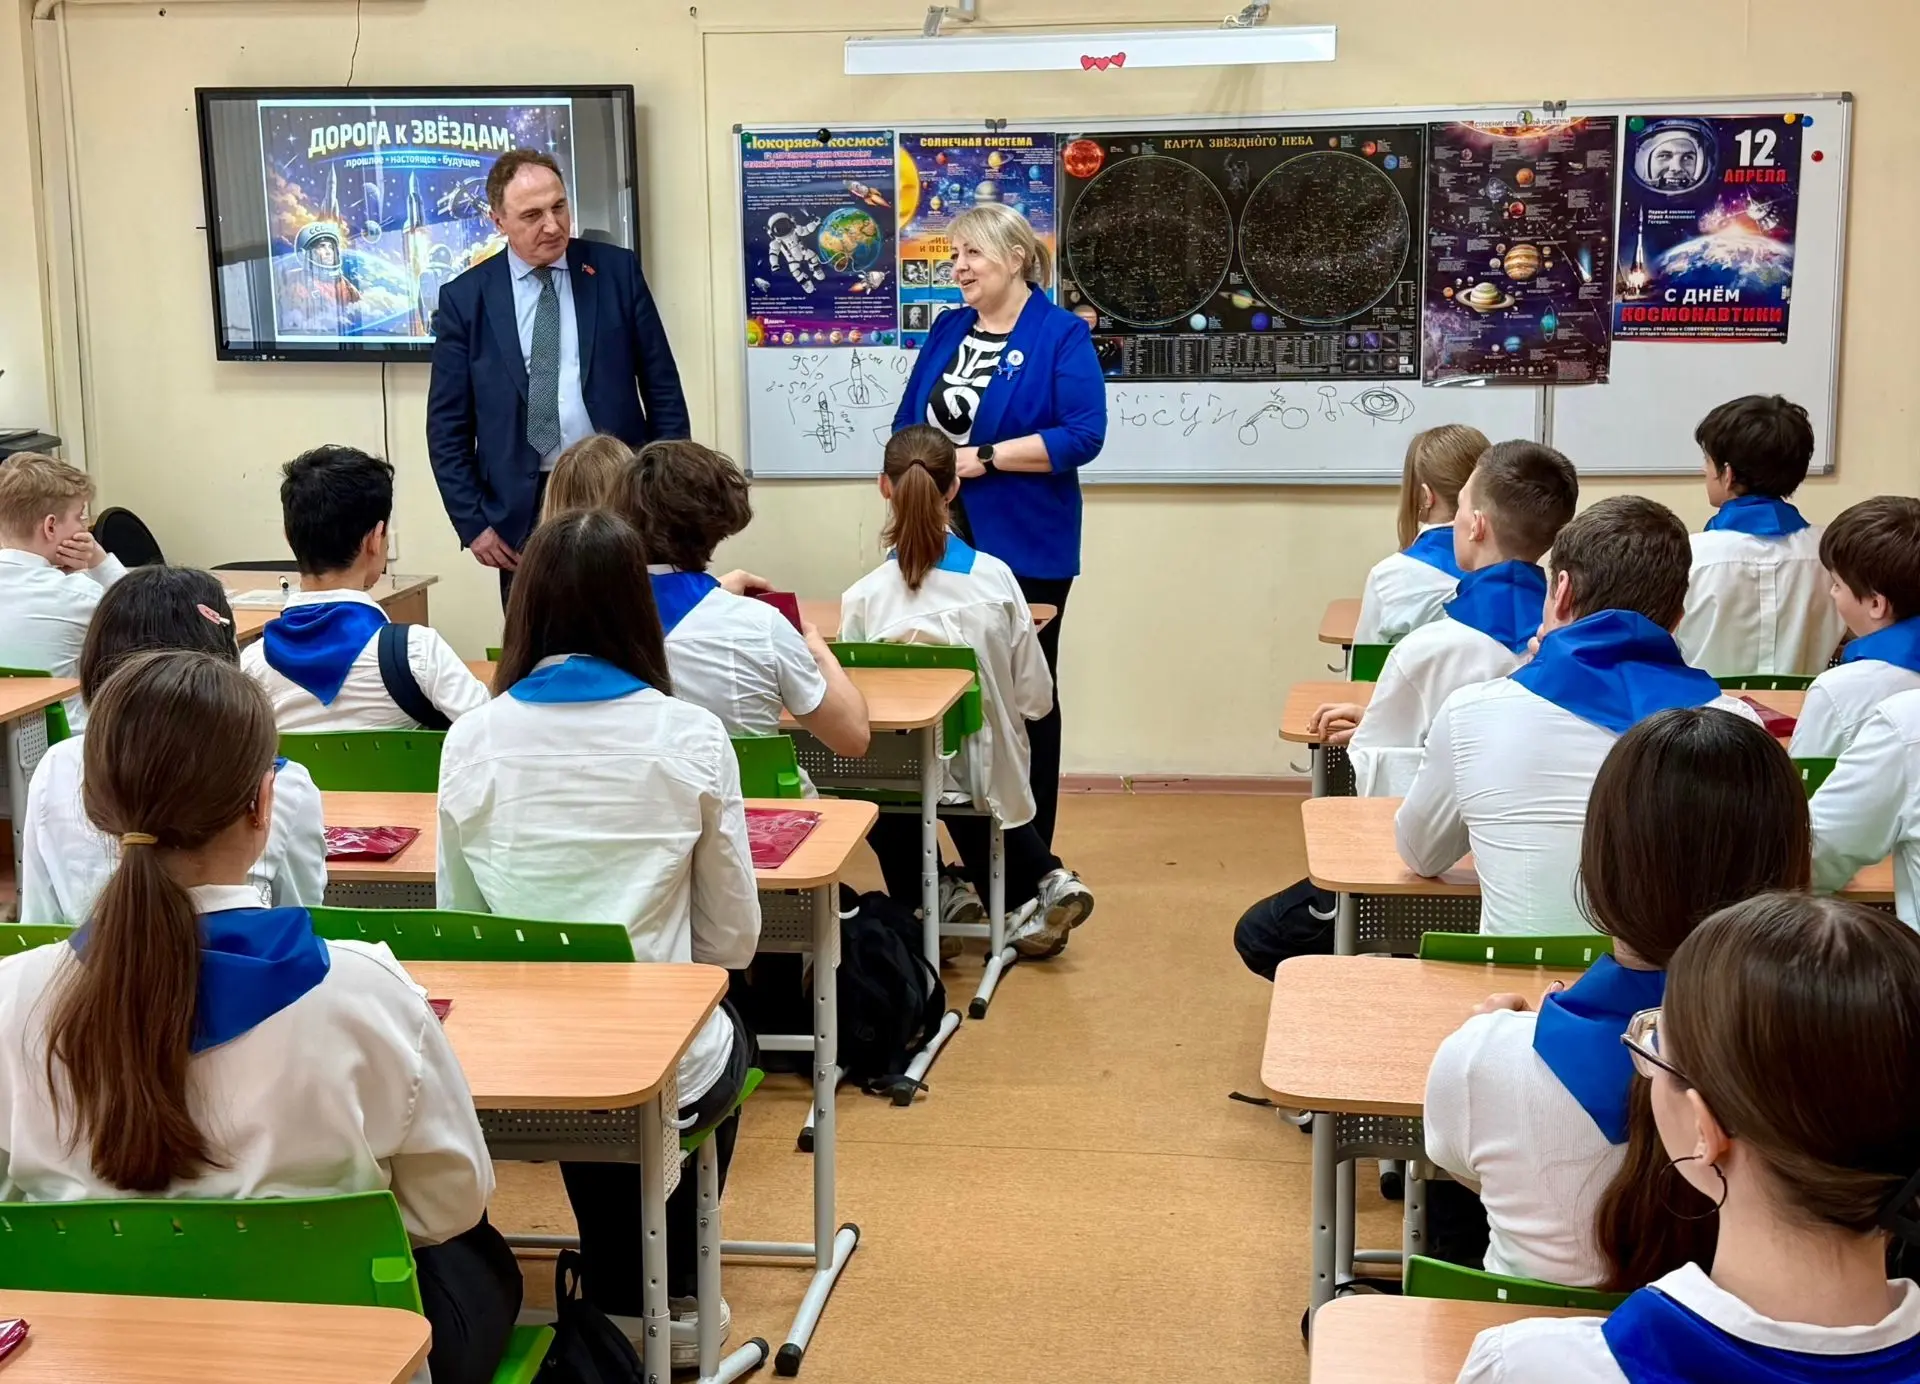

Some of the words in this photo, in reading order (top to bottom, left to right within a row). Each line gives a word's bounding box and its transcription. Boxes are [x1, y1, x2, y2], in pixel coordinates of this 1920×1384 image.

[308, 120, 392, 158] ДОРОГА
[411, 115, 517, 151] ЗВЁЗДАМ:
[920, 137, 982, 147] СОЛНЕЧНАЯ
[984, 136, 1033, 147] СИСТЕМА
[1164, 139, 1204, 149] КАРТА
[1209, 136, 1277, 149] ЗВЁЗДНОГО
[1282, 136, 1314, 146] НЕБА
[1735, 128, 1777, 167] 12
[346, 156, 384, 169] прошлое
[391, 155, 437, 166] настоящее
[443, 155, 481, 168] будущее
[1724, 168, 1788, 183] АПРЕЛЯ
[1664, 288, 1676, 303] С
[1682, 285, 1740, 304] ДНЁМ
[1621, 306, 1784, 323] КОСМОНАВТИКИ
